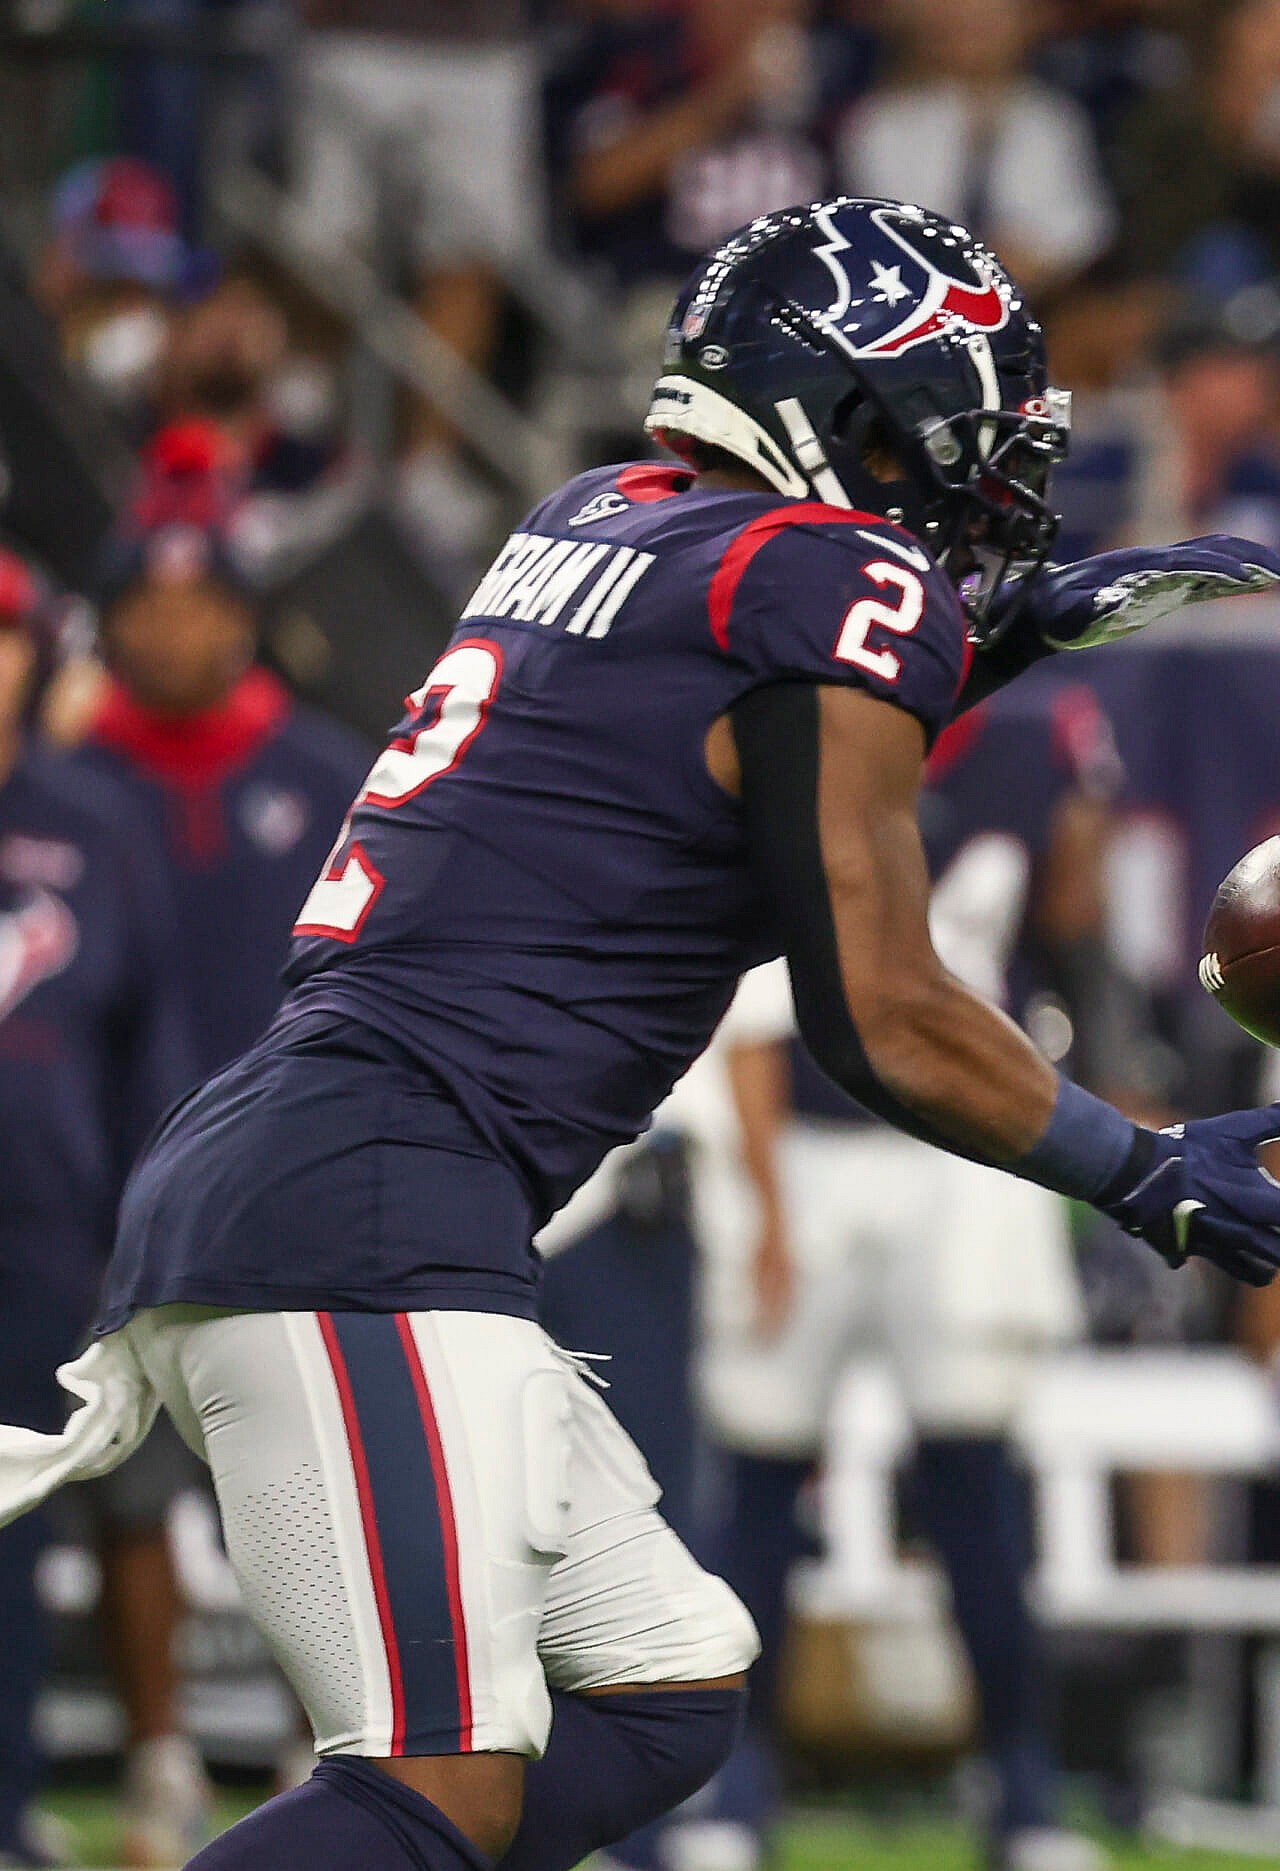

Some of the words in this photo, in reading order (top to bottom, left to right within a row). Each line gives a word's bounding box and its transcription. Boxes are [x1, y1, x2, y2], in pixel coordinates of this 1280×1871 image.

[564, 545, 657, 640] II
[836, 557, 925, 682] 2
[292, 637, 503, 944] 2
